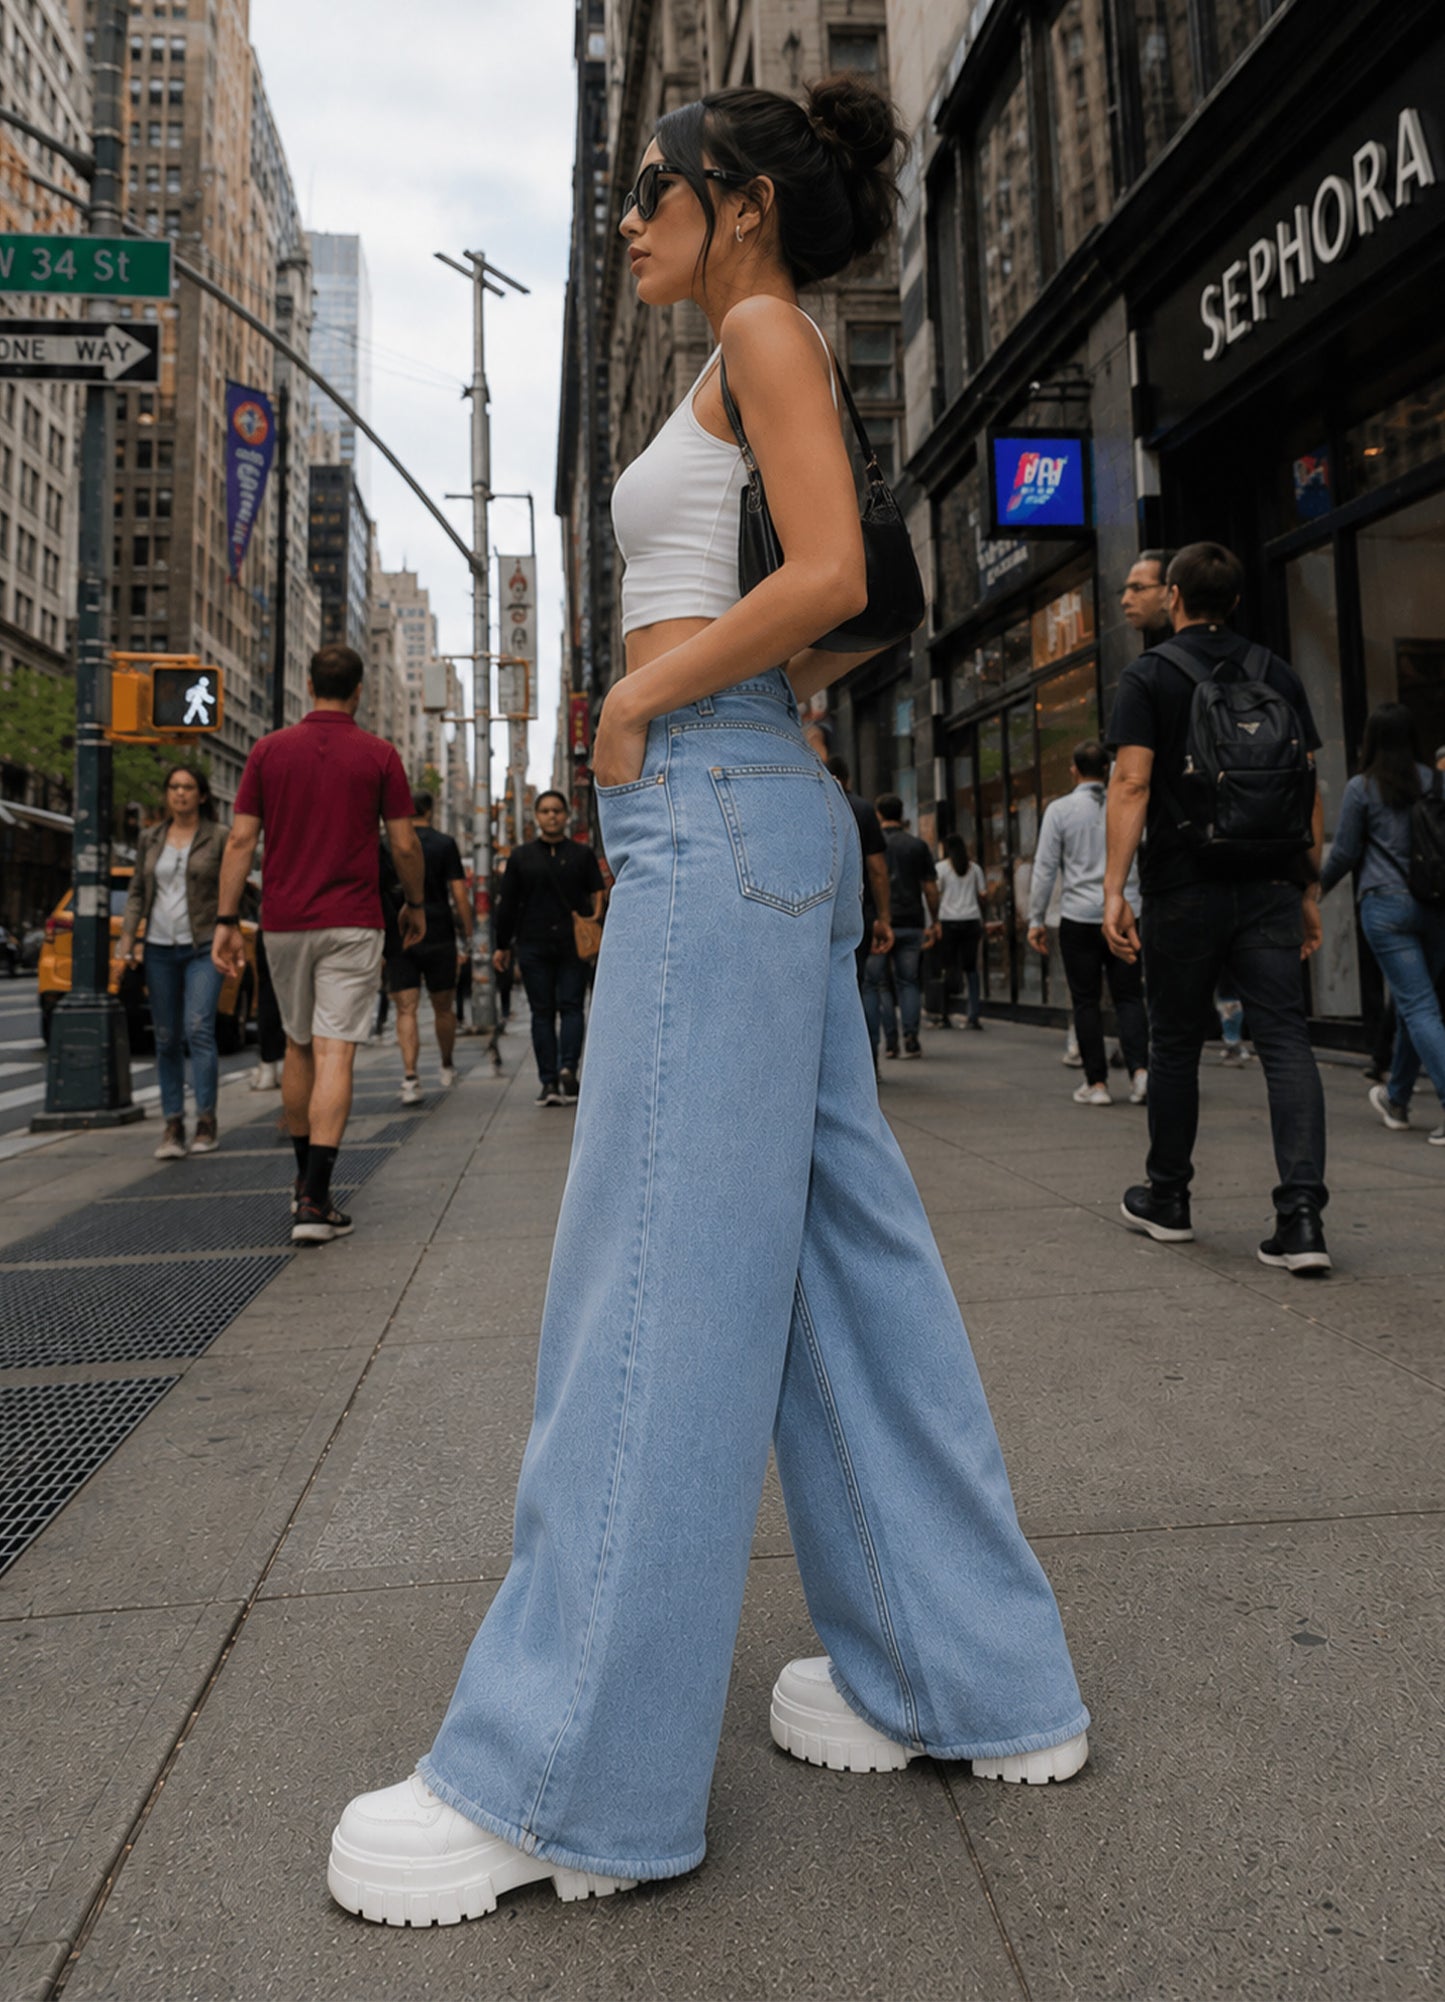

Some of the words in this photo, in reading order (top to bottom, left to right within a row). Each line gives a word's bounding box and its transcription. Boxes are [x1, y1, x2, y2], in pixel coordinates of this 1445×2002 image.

[1201, 107, 1435, 361] SEPHORA
[31, 248, 77, 281] 34
[93, 250, 130, 282] St
[0, 338, 45, 360] ONE
[75, 341, 132, 361] WAY
